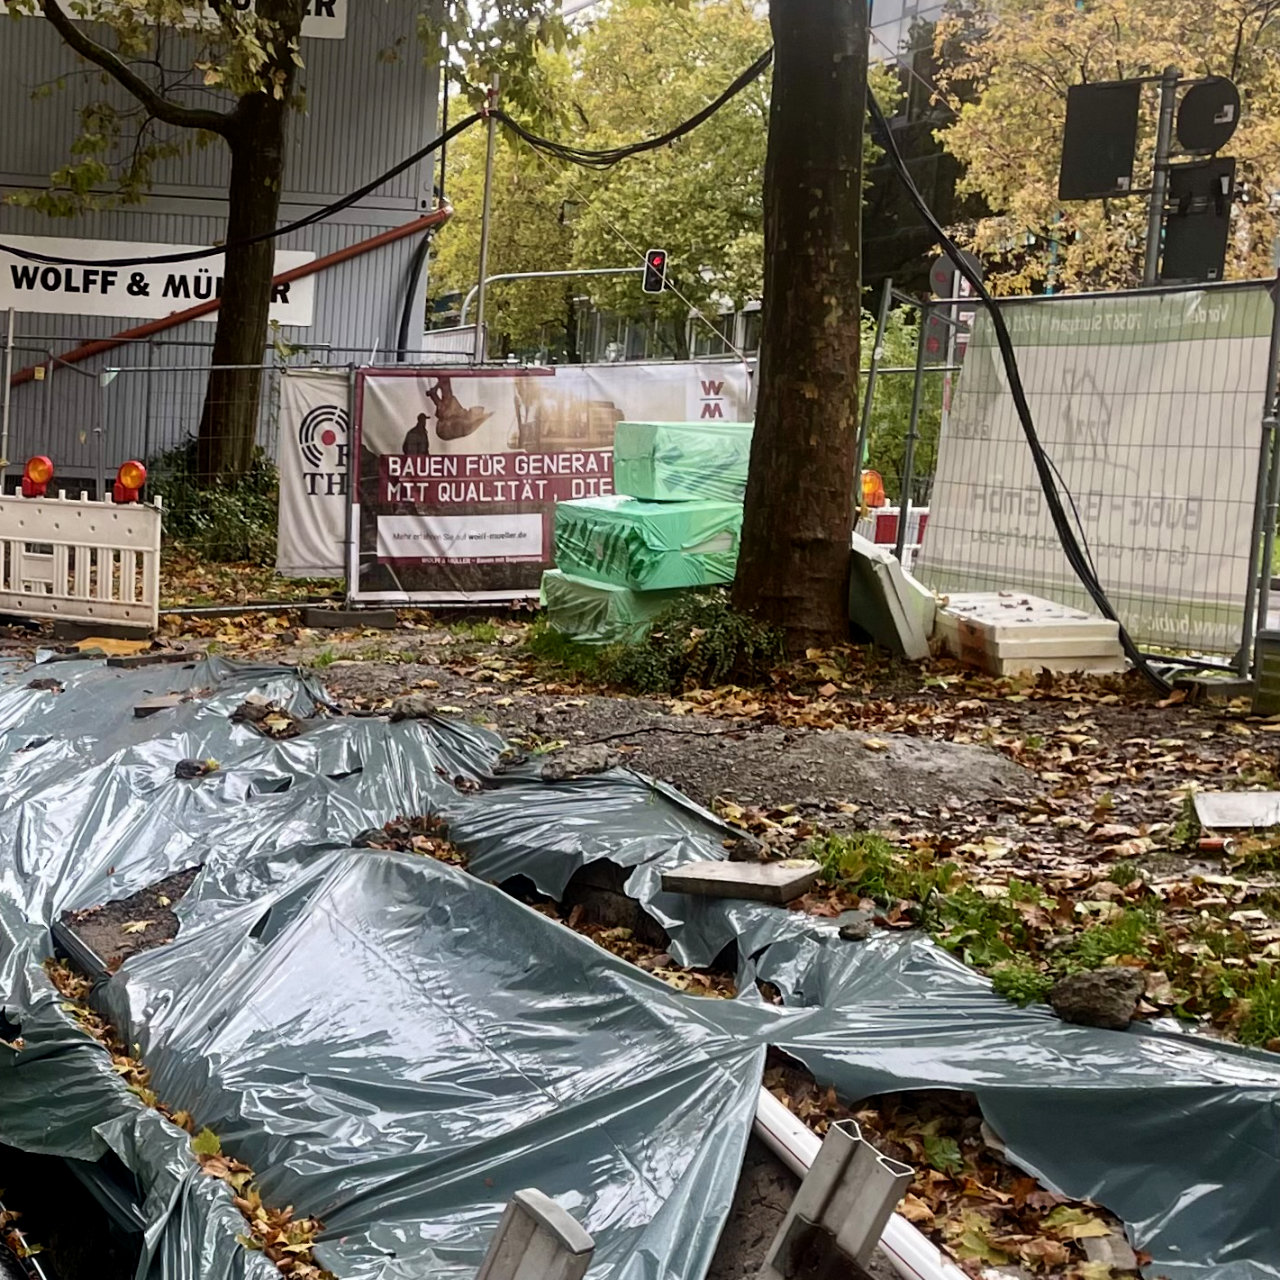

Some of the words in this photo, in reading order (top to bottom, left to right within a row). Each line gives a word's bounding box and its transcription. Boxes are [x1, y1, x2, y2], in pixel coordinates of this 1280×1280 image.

[10, 264, 118, 295] WOLFF
[126, 272, 150, 297] &
[161, 267, 290, 304] MÜR
[388, 456, 457, 478] BAUEN
[466, 454, 505, 476] FÜR
[514, 452, 613, 475] GENERAT
[387, 481, 429, 502] MIT
[571, 478, 613, 499] DIE
